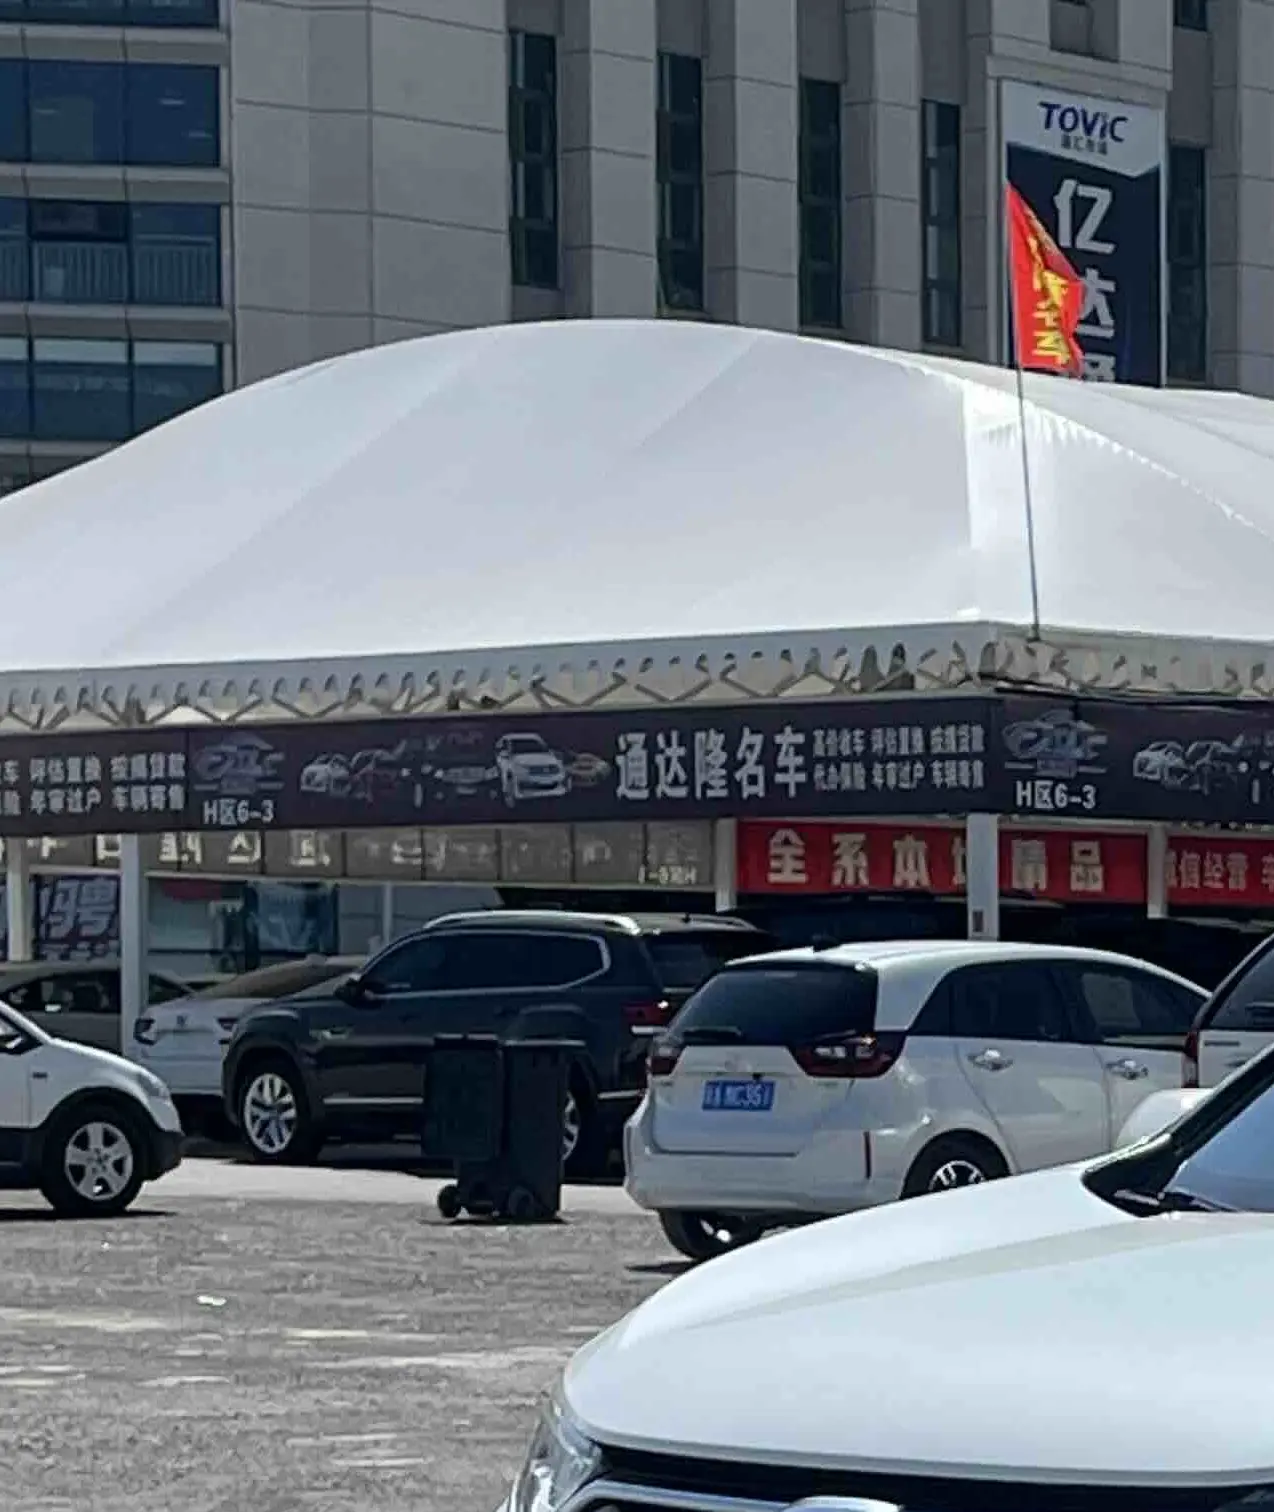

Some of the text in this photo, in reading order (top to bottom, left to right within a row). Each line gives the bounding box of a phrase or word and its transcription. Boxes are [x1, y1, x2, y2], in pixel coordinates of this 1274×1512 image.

[614, 725, 808, 801] 通达隆名车
[1015, 780, 1098, 809] H区6-3
[203, 798, 275, 826] H区6-3
